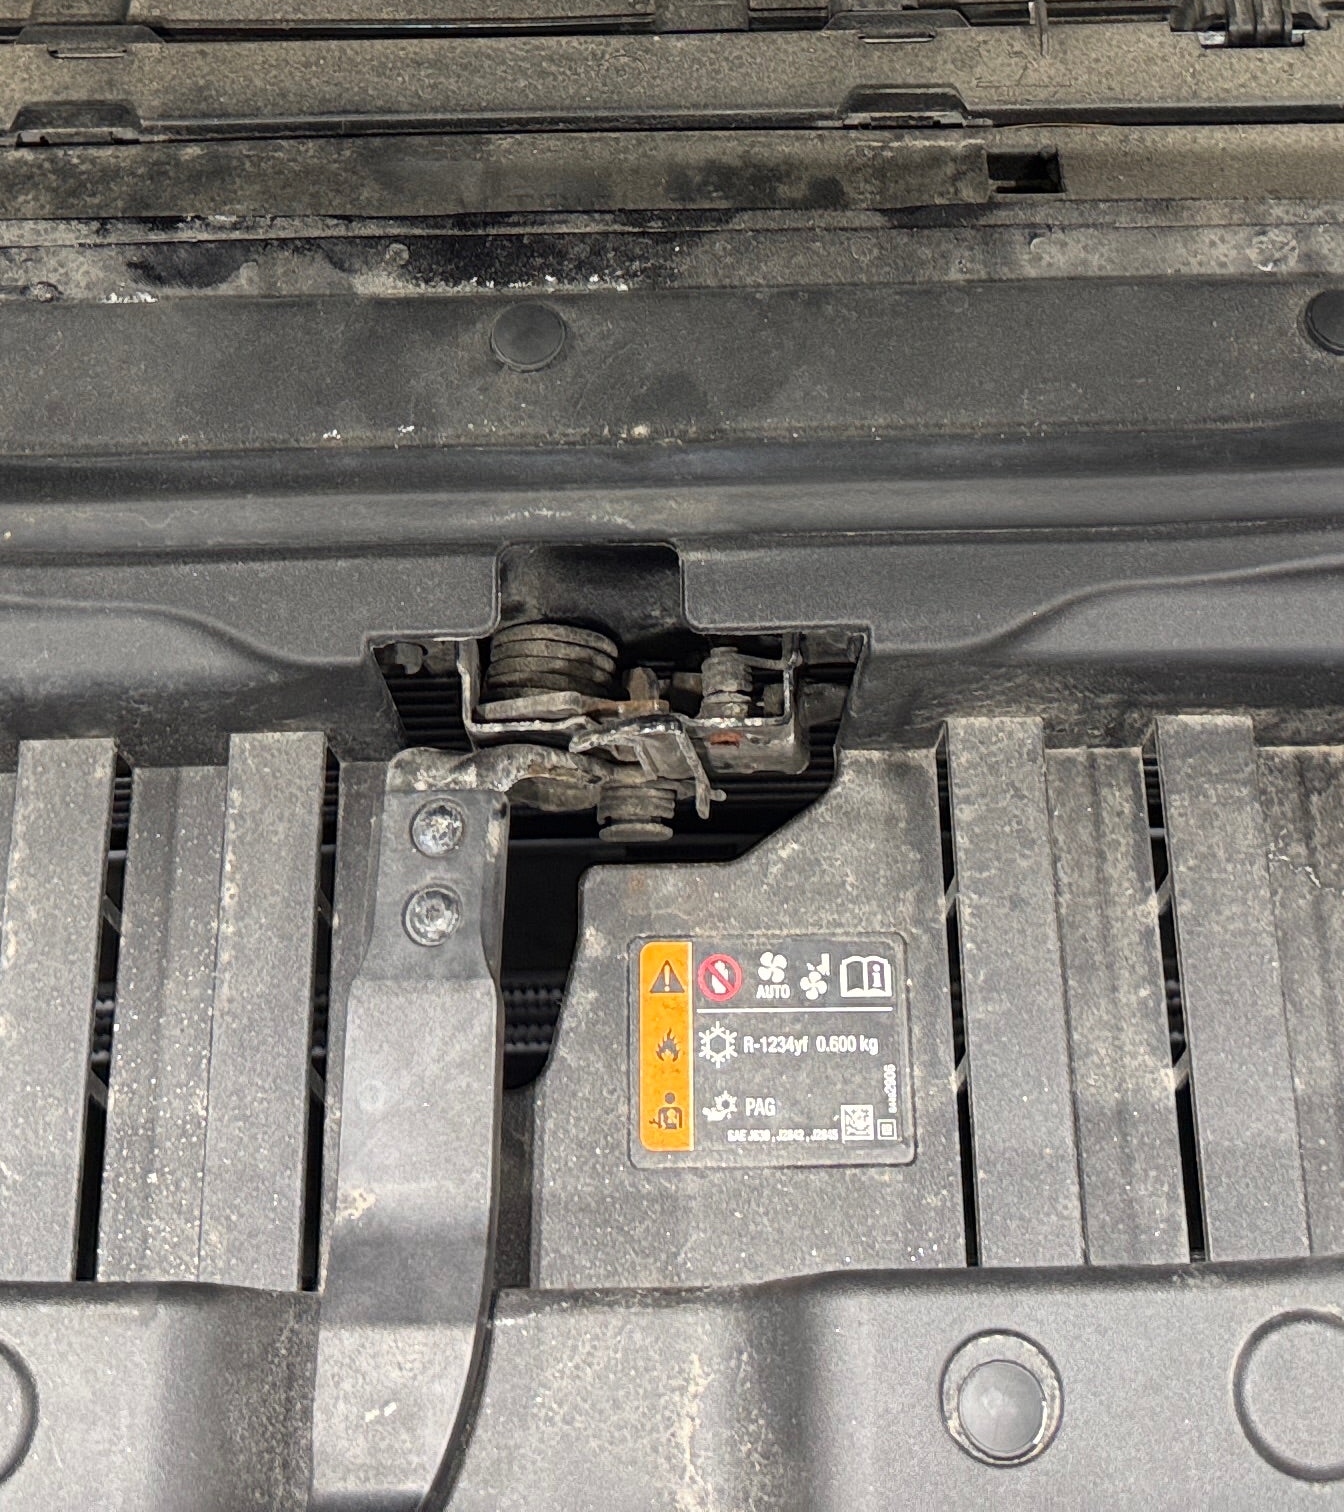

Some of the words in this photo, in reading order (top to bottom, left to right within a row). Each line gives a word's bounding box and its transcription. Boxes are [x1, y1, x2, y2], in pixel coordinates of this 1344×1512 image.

[755, 984, 790, 999] AUTO
[743, 1036, 809, 1056] R-1234yf
[816, 1035, 857, 1053] 0.600
[860, 1035, 879, 1056] kg
[745, 1097, 776, 1117] PAG
